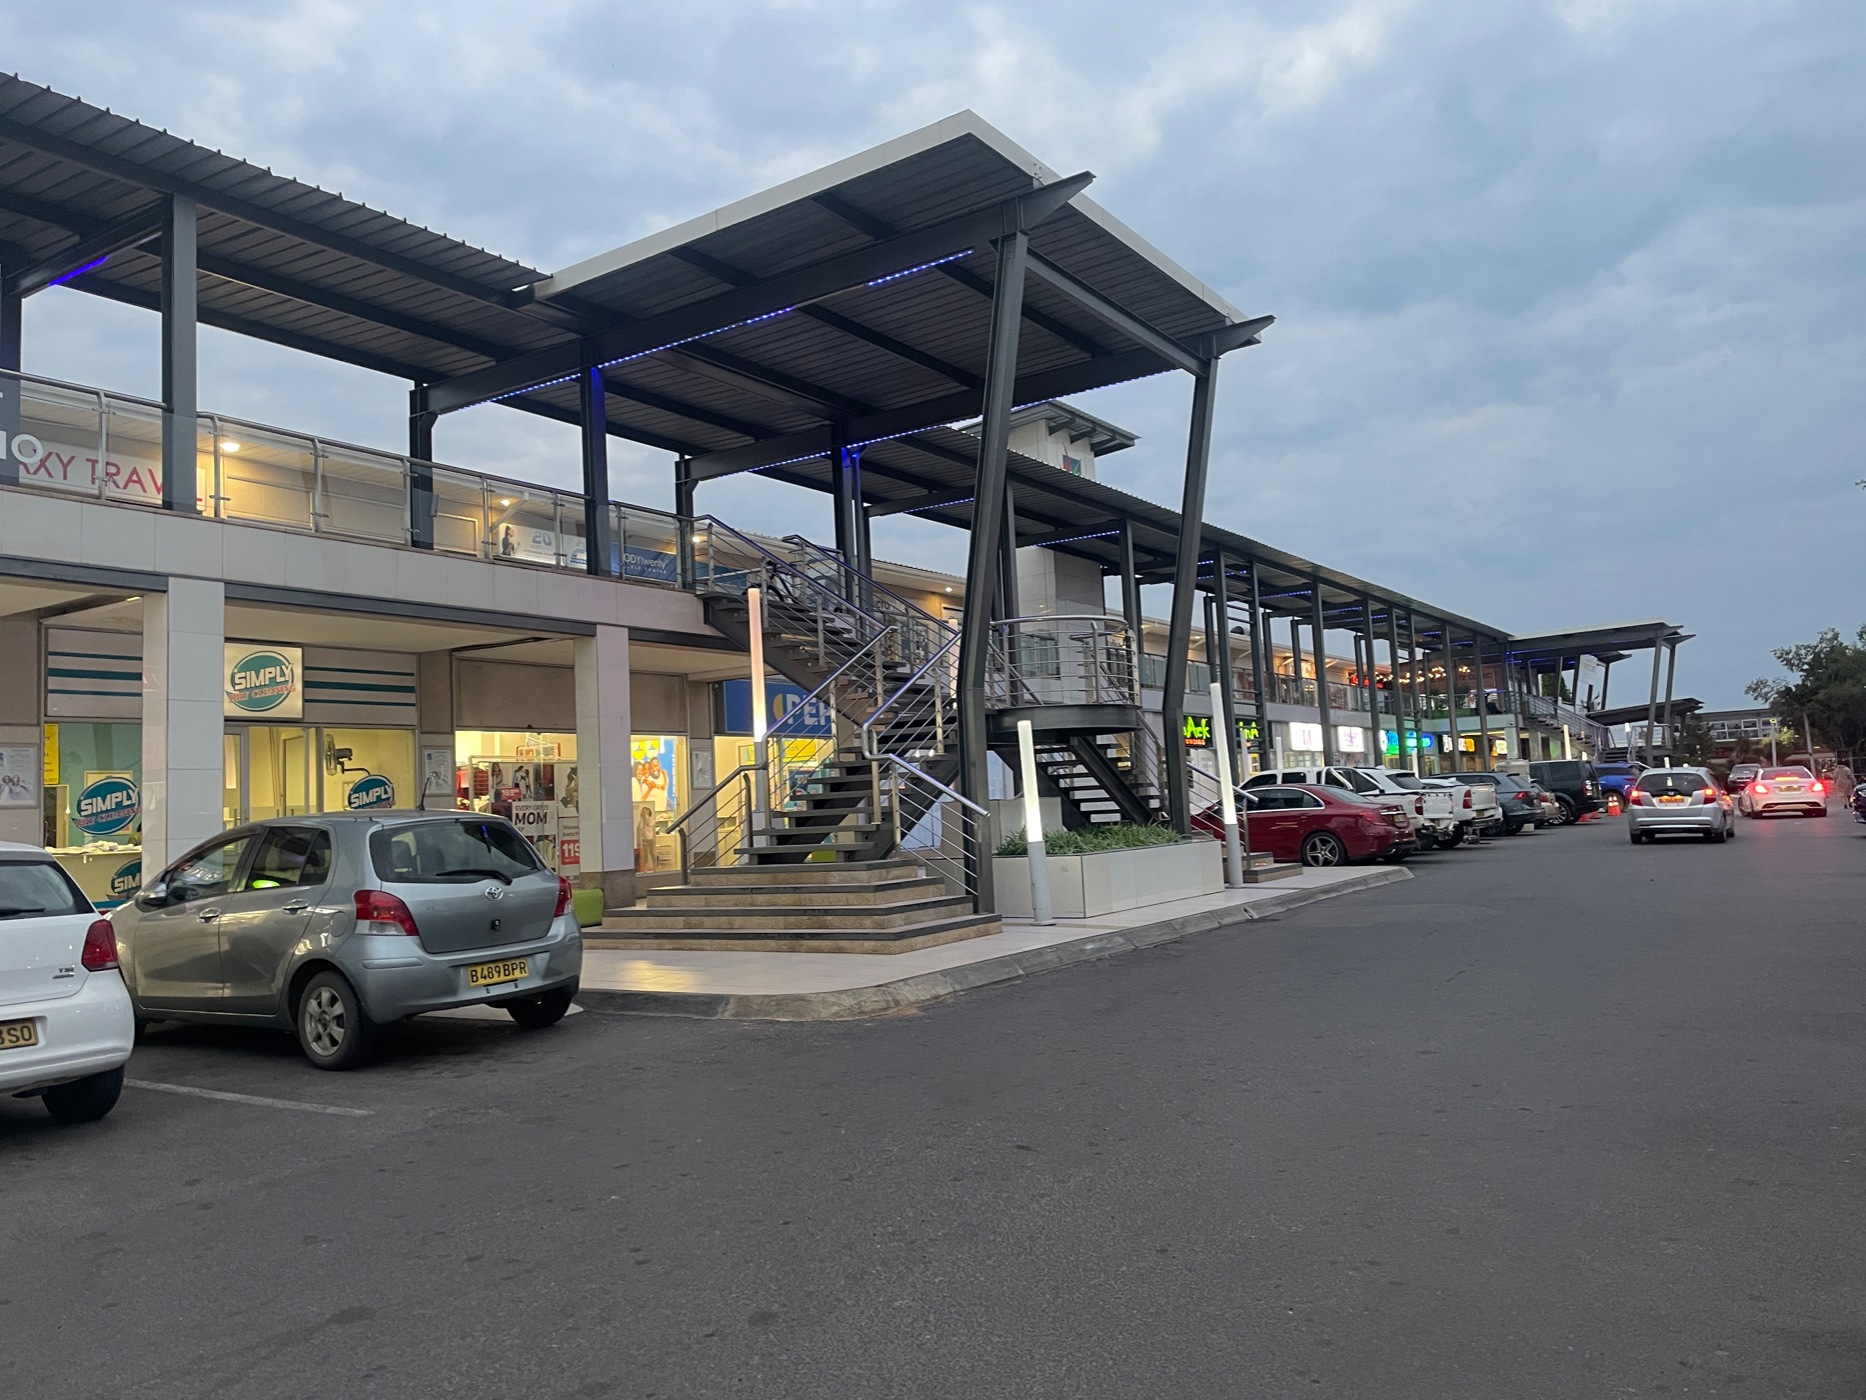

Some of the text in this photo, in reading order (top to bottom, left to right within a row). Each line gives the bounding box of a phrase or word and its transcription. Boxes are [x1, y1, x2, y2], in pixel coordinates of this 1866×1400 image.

[234, 664, 293, 691] SIMPLY
[81, 788, 139, 817] SIMPLY
[350, 785, 393, 808] SIMPLY
[515, 812, 547, 826] MOM
[114, 873, 141, 893] SIM
